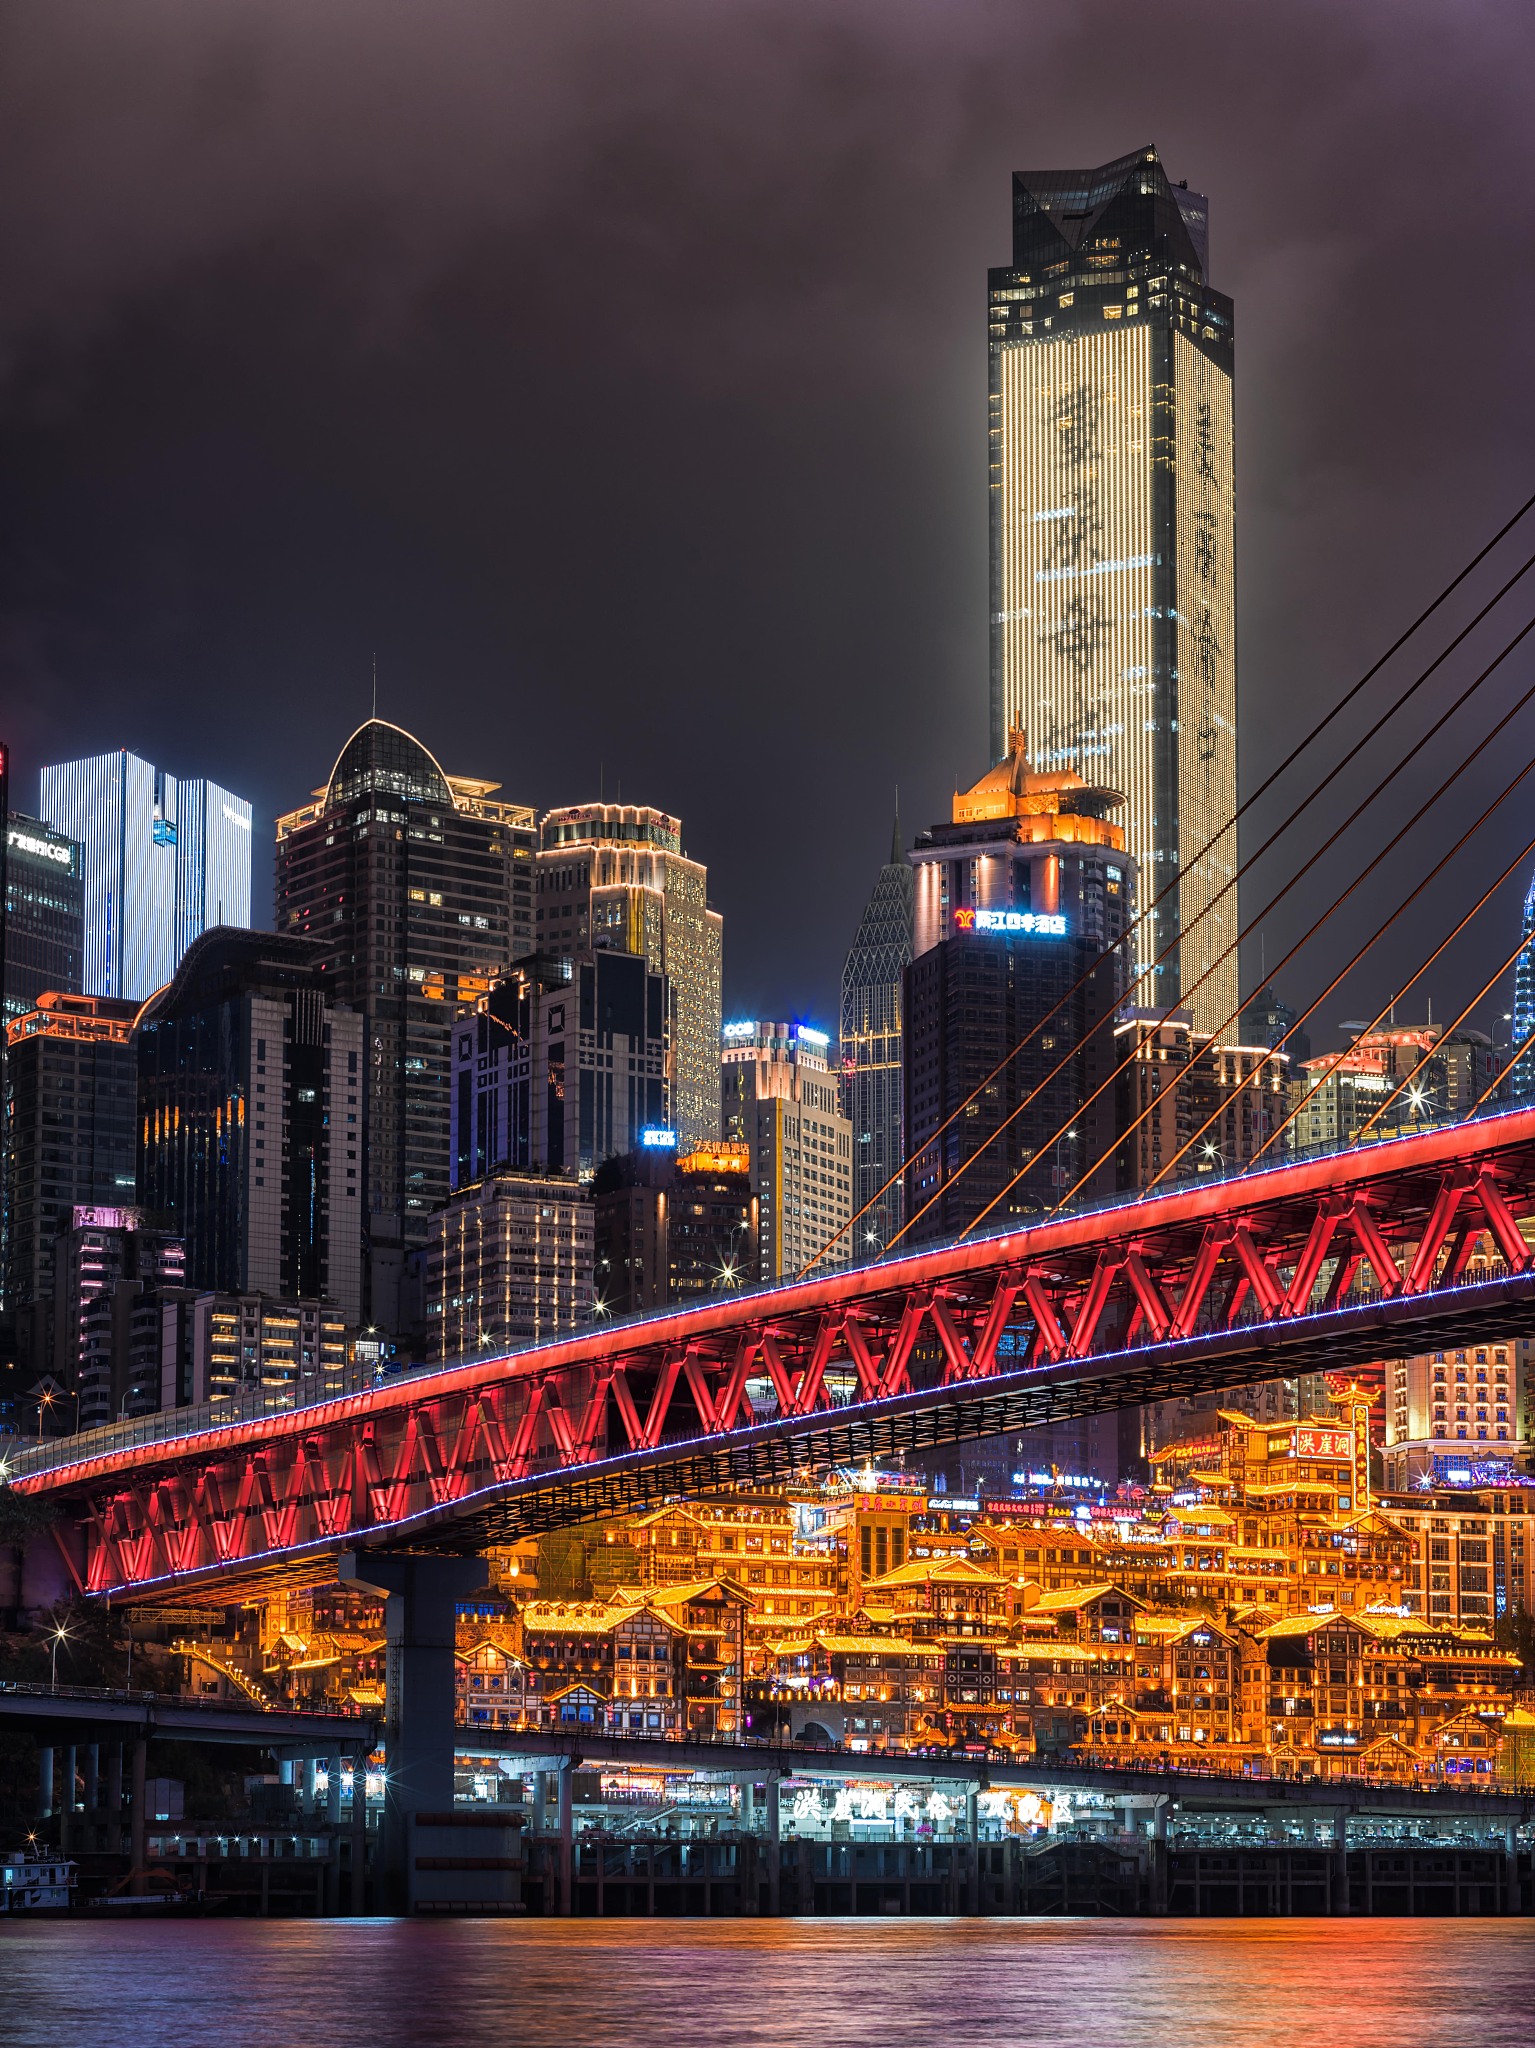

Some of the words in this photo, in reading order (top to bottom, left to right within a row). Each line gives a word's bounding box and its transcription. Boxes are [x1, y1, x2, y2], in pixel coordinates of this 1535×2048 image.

[47, 843, 71, 864] CGB
[694, 1140, 750, 1155] 7天优品酒店
[1299, 1432, 1350, 1456] 洪崖洞
